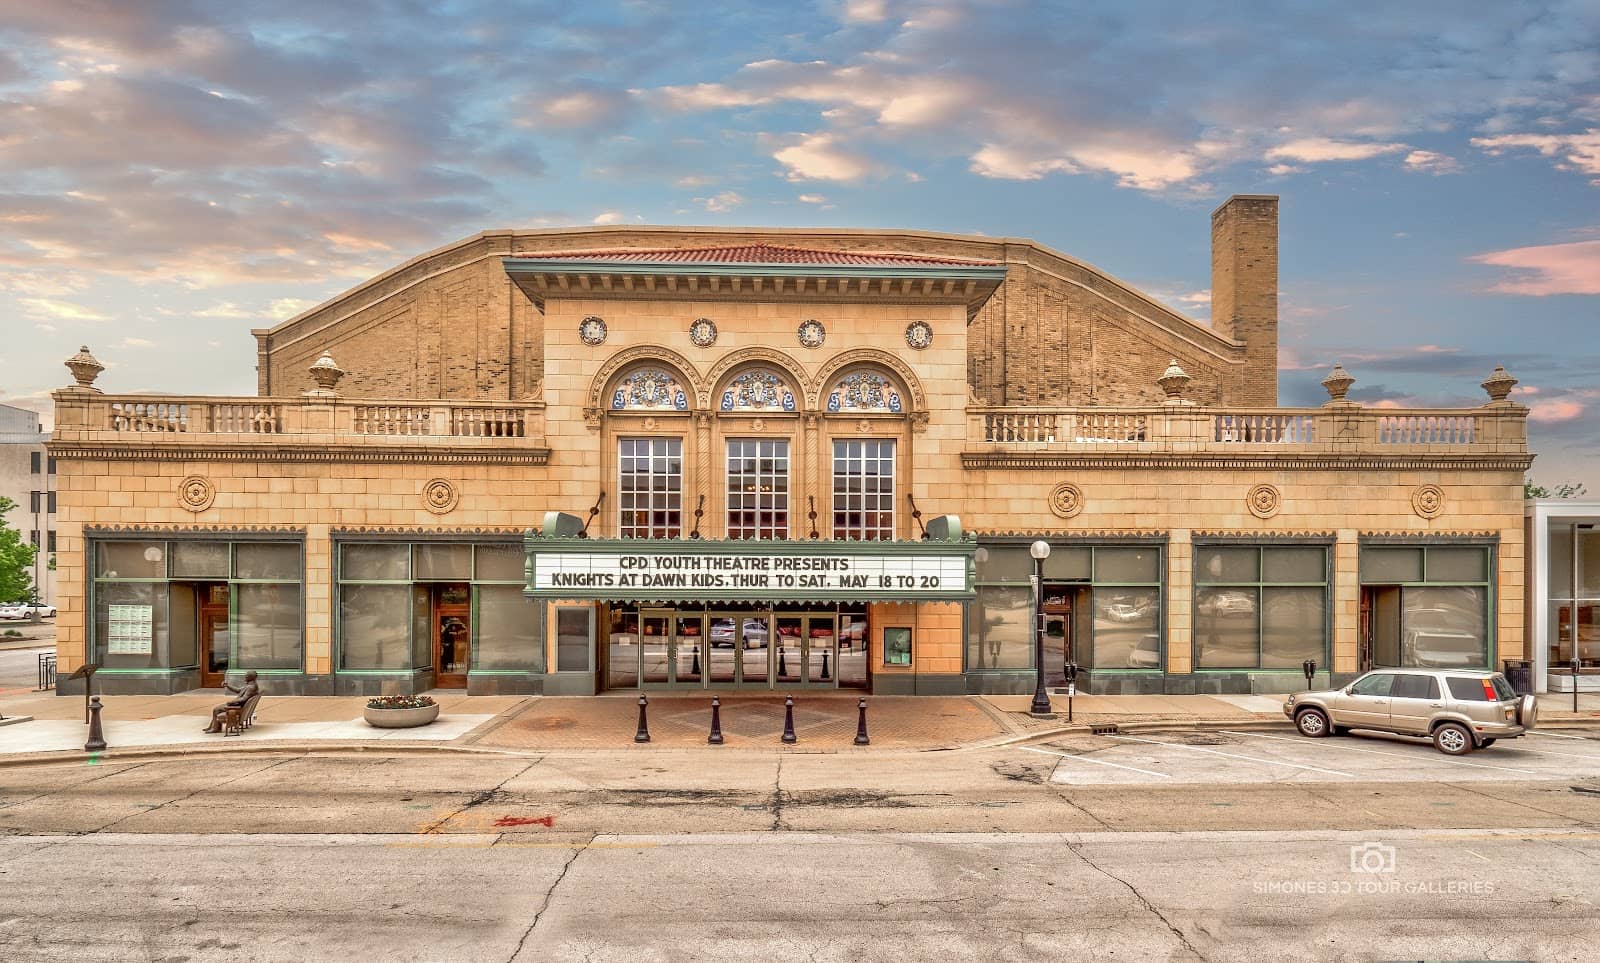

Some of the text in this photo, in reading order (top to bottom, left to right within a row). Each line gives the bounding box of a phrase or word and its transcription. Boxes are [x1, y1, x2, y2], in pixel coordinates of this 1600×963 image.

[620, 556, 848, 570] CPD YOUTH THEATRE PRESENTS
[552, 573, 613, 587] KNIGHTS
[619, 573, 638, 587] AT
[643, 573, 686, 587] DAWN
[731, 574, 768, 587] THUR
[776, 575, 794, 587] TO
[799, 575, 831, 588] SAT.
[840, 575, 868, 588] MAY
[878, 575, 892, 588] 18
[897, 576, 915, 588] TO
[921, 576, 940, 588] 20
